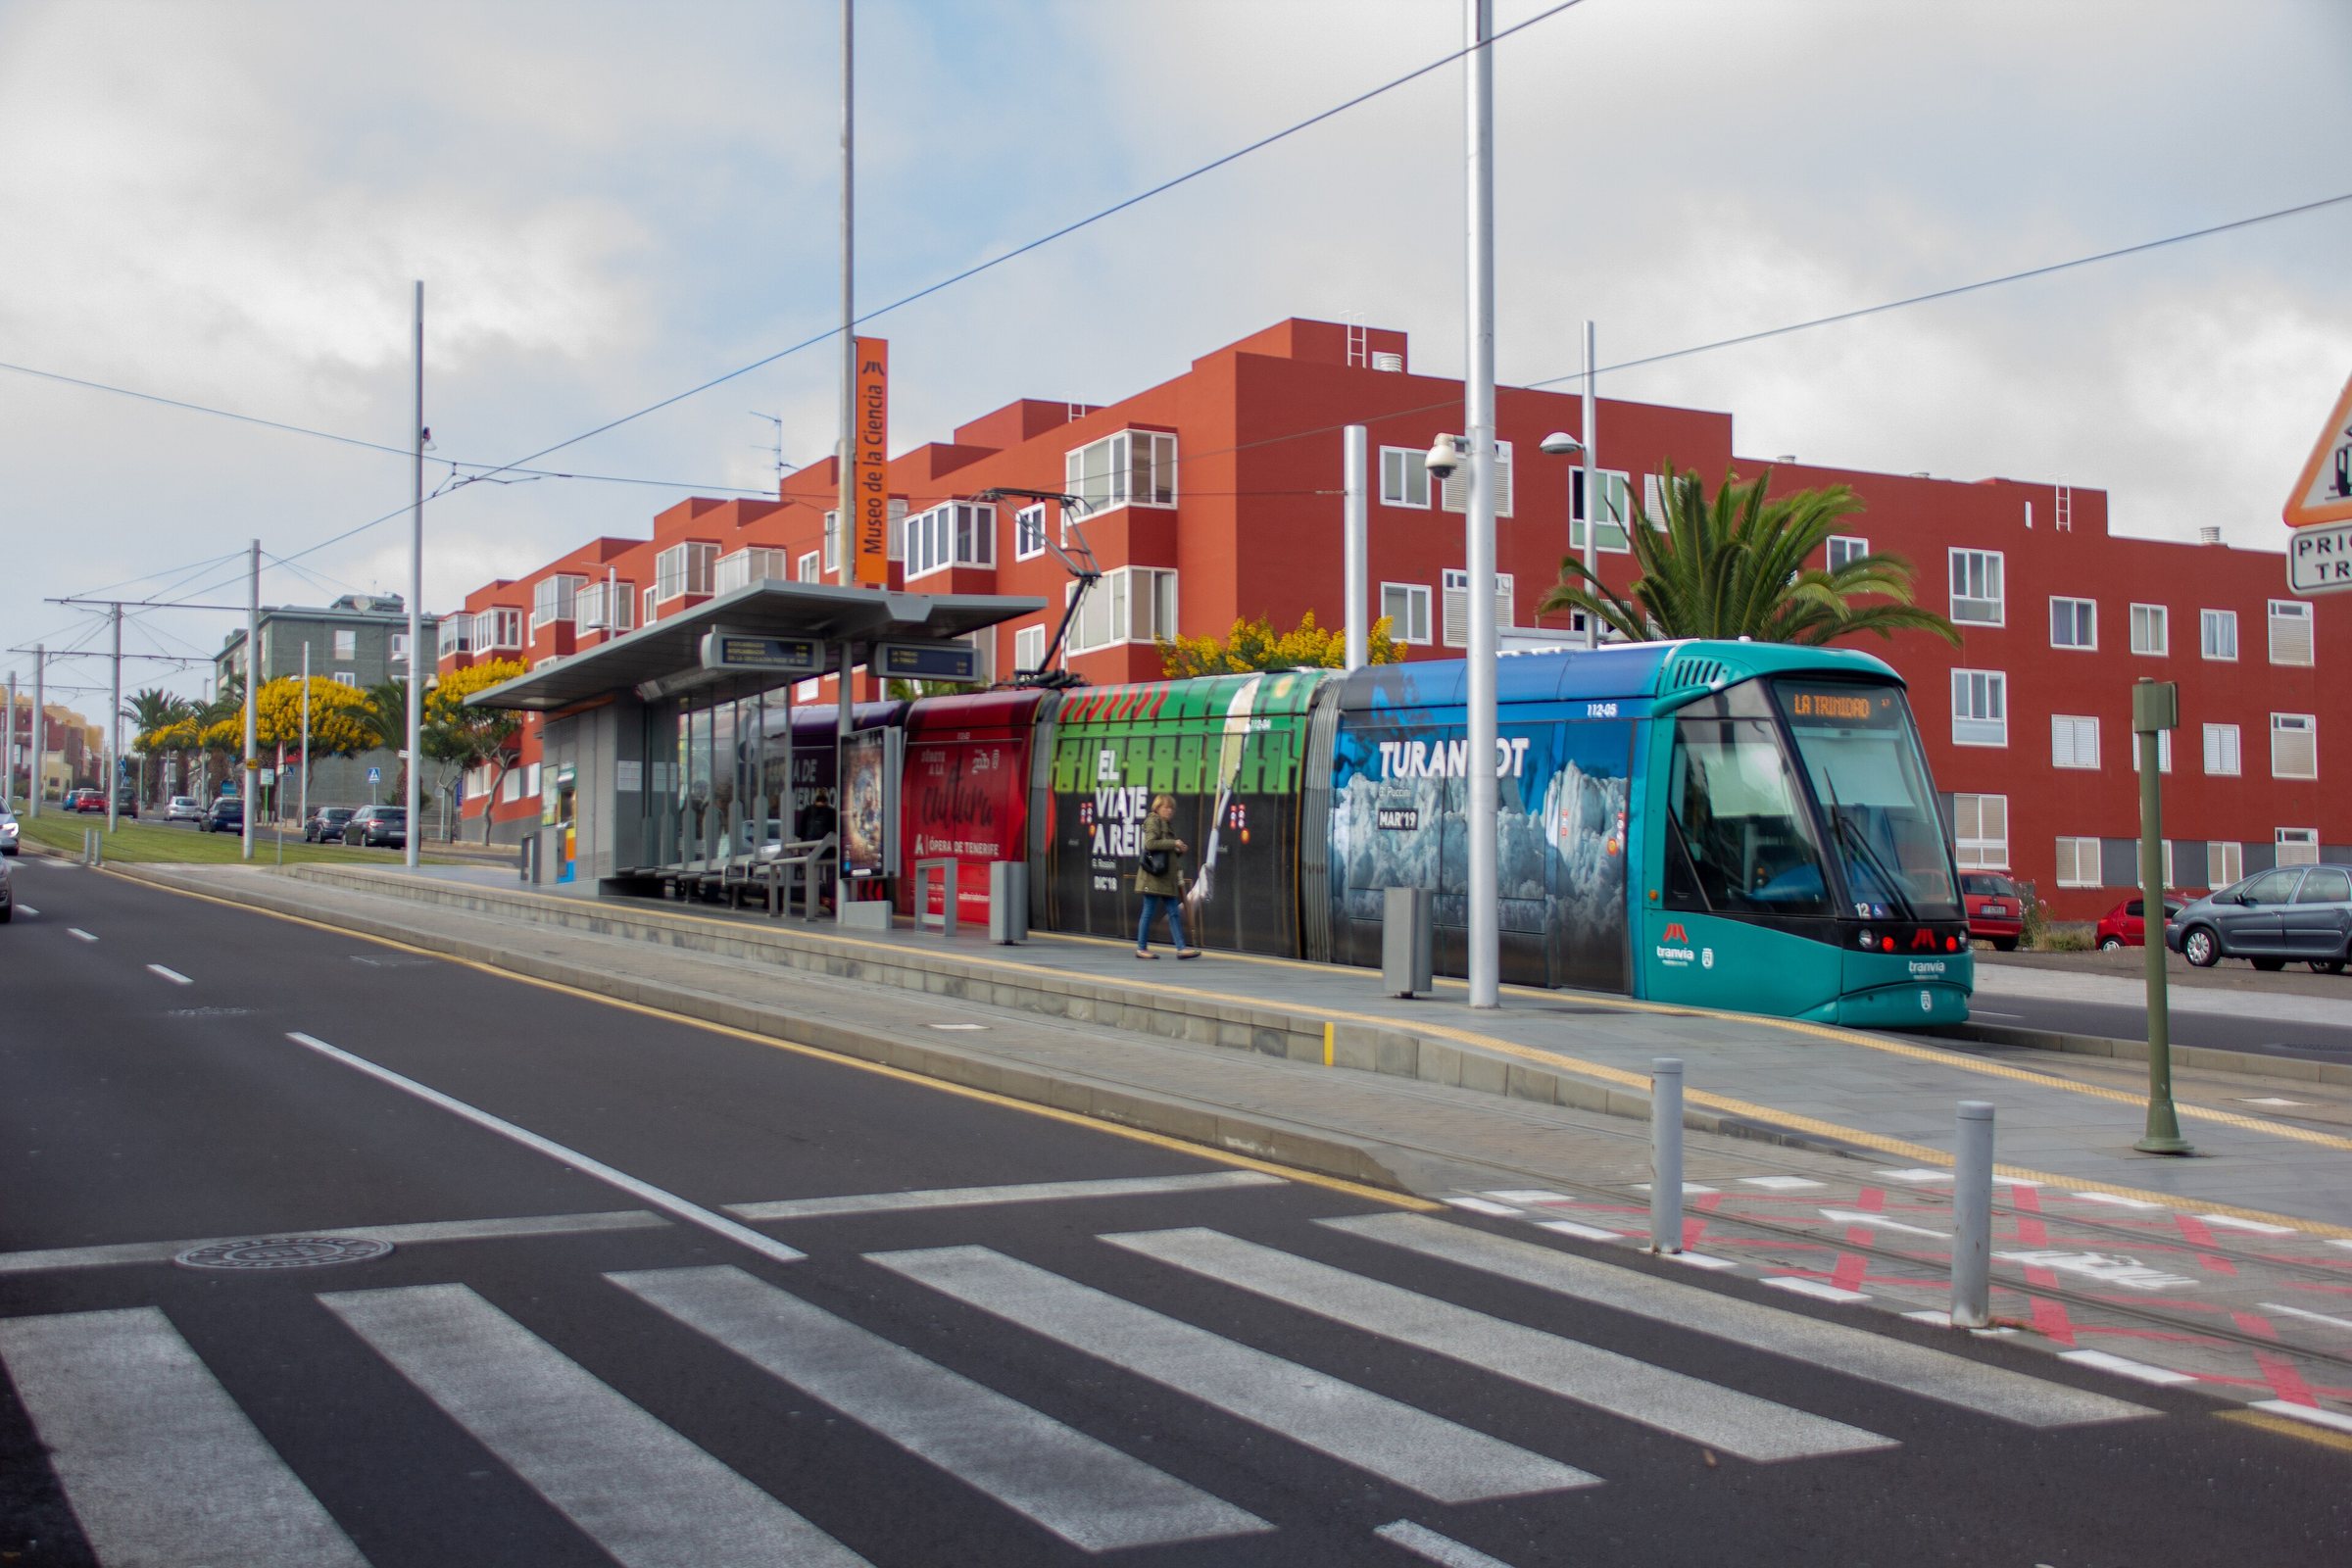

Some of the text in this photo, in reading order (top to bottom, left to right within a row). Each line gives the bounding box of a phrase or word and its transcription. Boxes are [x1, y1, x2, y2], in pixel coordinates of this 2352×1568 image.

[862, 383, 883, 555] Museo de la Ciencia
[2298, 534, 2352, 557] PRI
[1587, 703, 1618, 718] 112-05
[1793, 694, 1811, 715] LA
[1814, 695, 1870, 719] TRINIDAD
[1099, 750, 1120, 781] EL
[1379, 737, 1530, 779] TURANOT
[803, 759, 817, 782] DE
[1095, 785, 1149, 825] VIAJE
[1379, 810, 1417, 827] MAR'19
[929, 837, 953, 852] ÓPERA
[954, 840, 963, 854] DE
[964, 841, 999, 857] TENERIFE
[1092, 823, 1147, 858] A REI
[1855, 903, 1871, 919] 12
